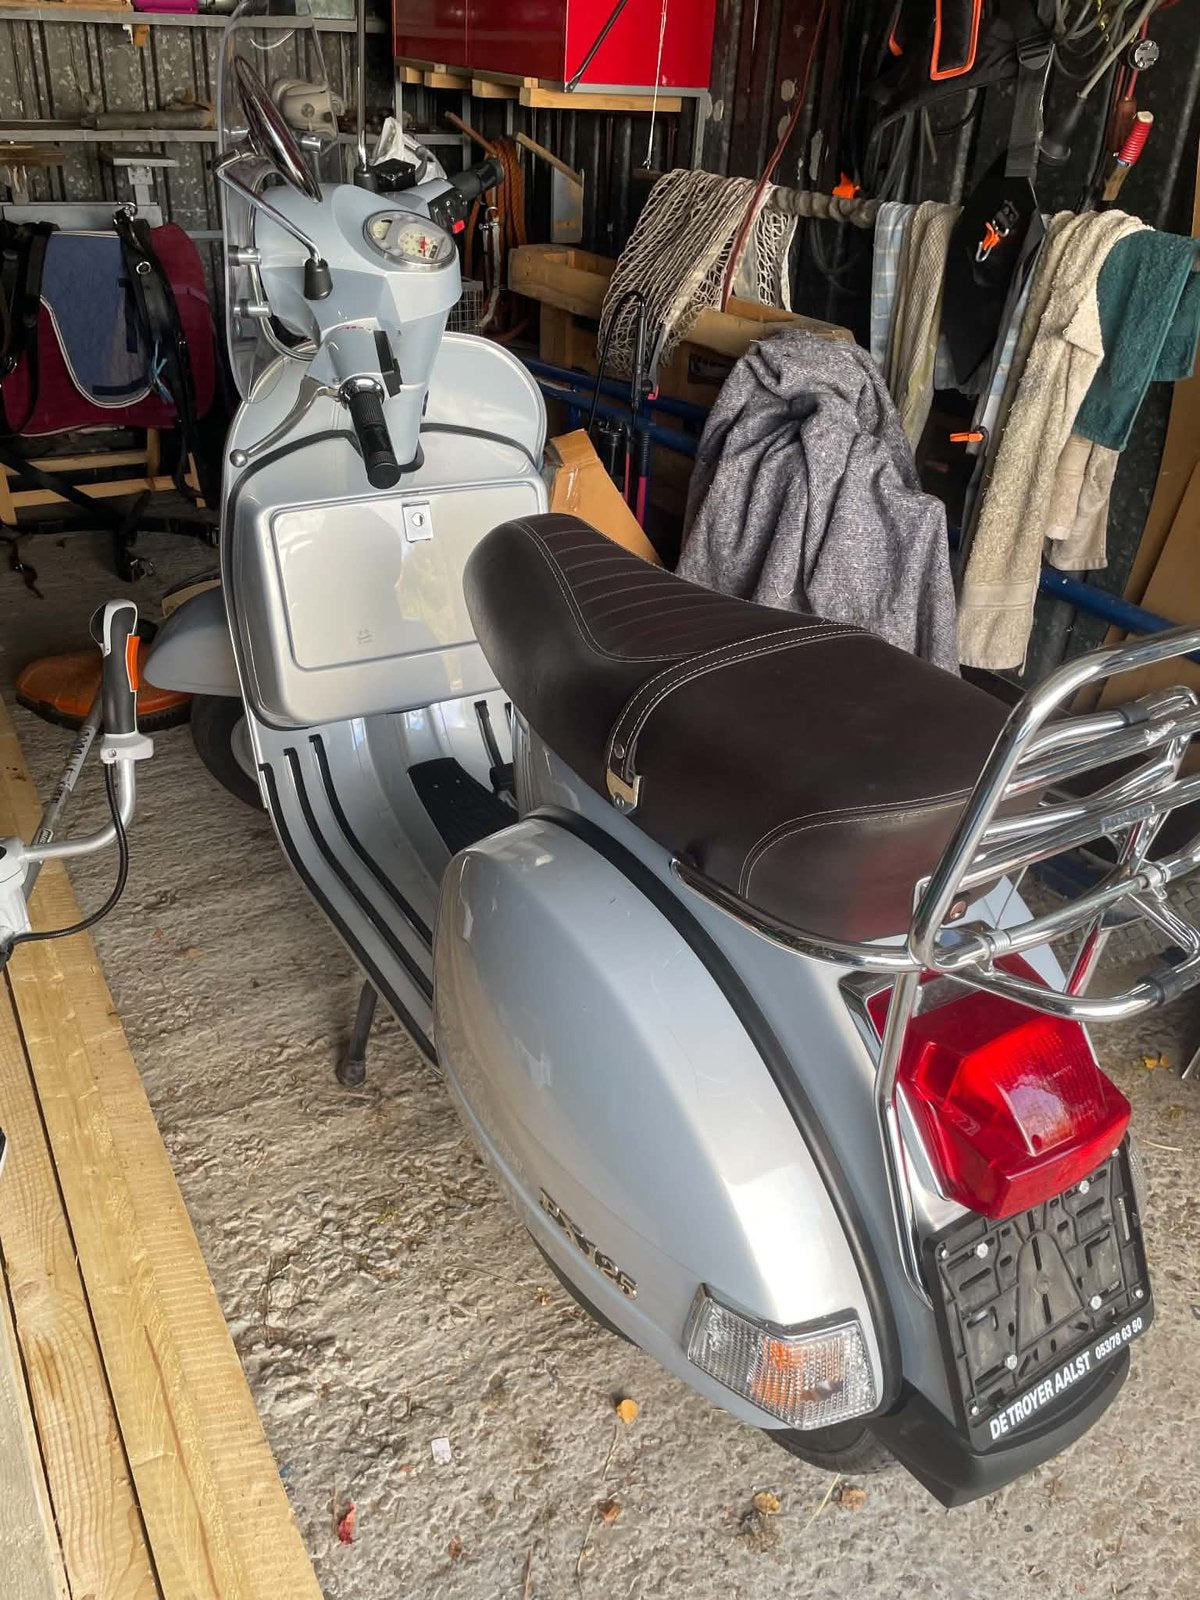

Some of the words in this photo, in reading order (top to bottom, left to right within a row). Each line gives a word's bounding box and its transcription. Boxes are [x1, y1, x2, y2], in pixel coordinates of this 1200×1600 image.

[1055, 1351, 1091, 1393] AALST
[1095, 1333, 1121, 1359] 053/78
[1121, 1325, 1132, 1341] 63
